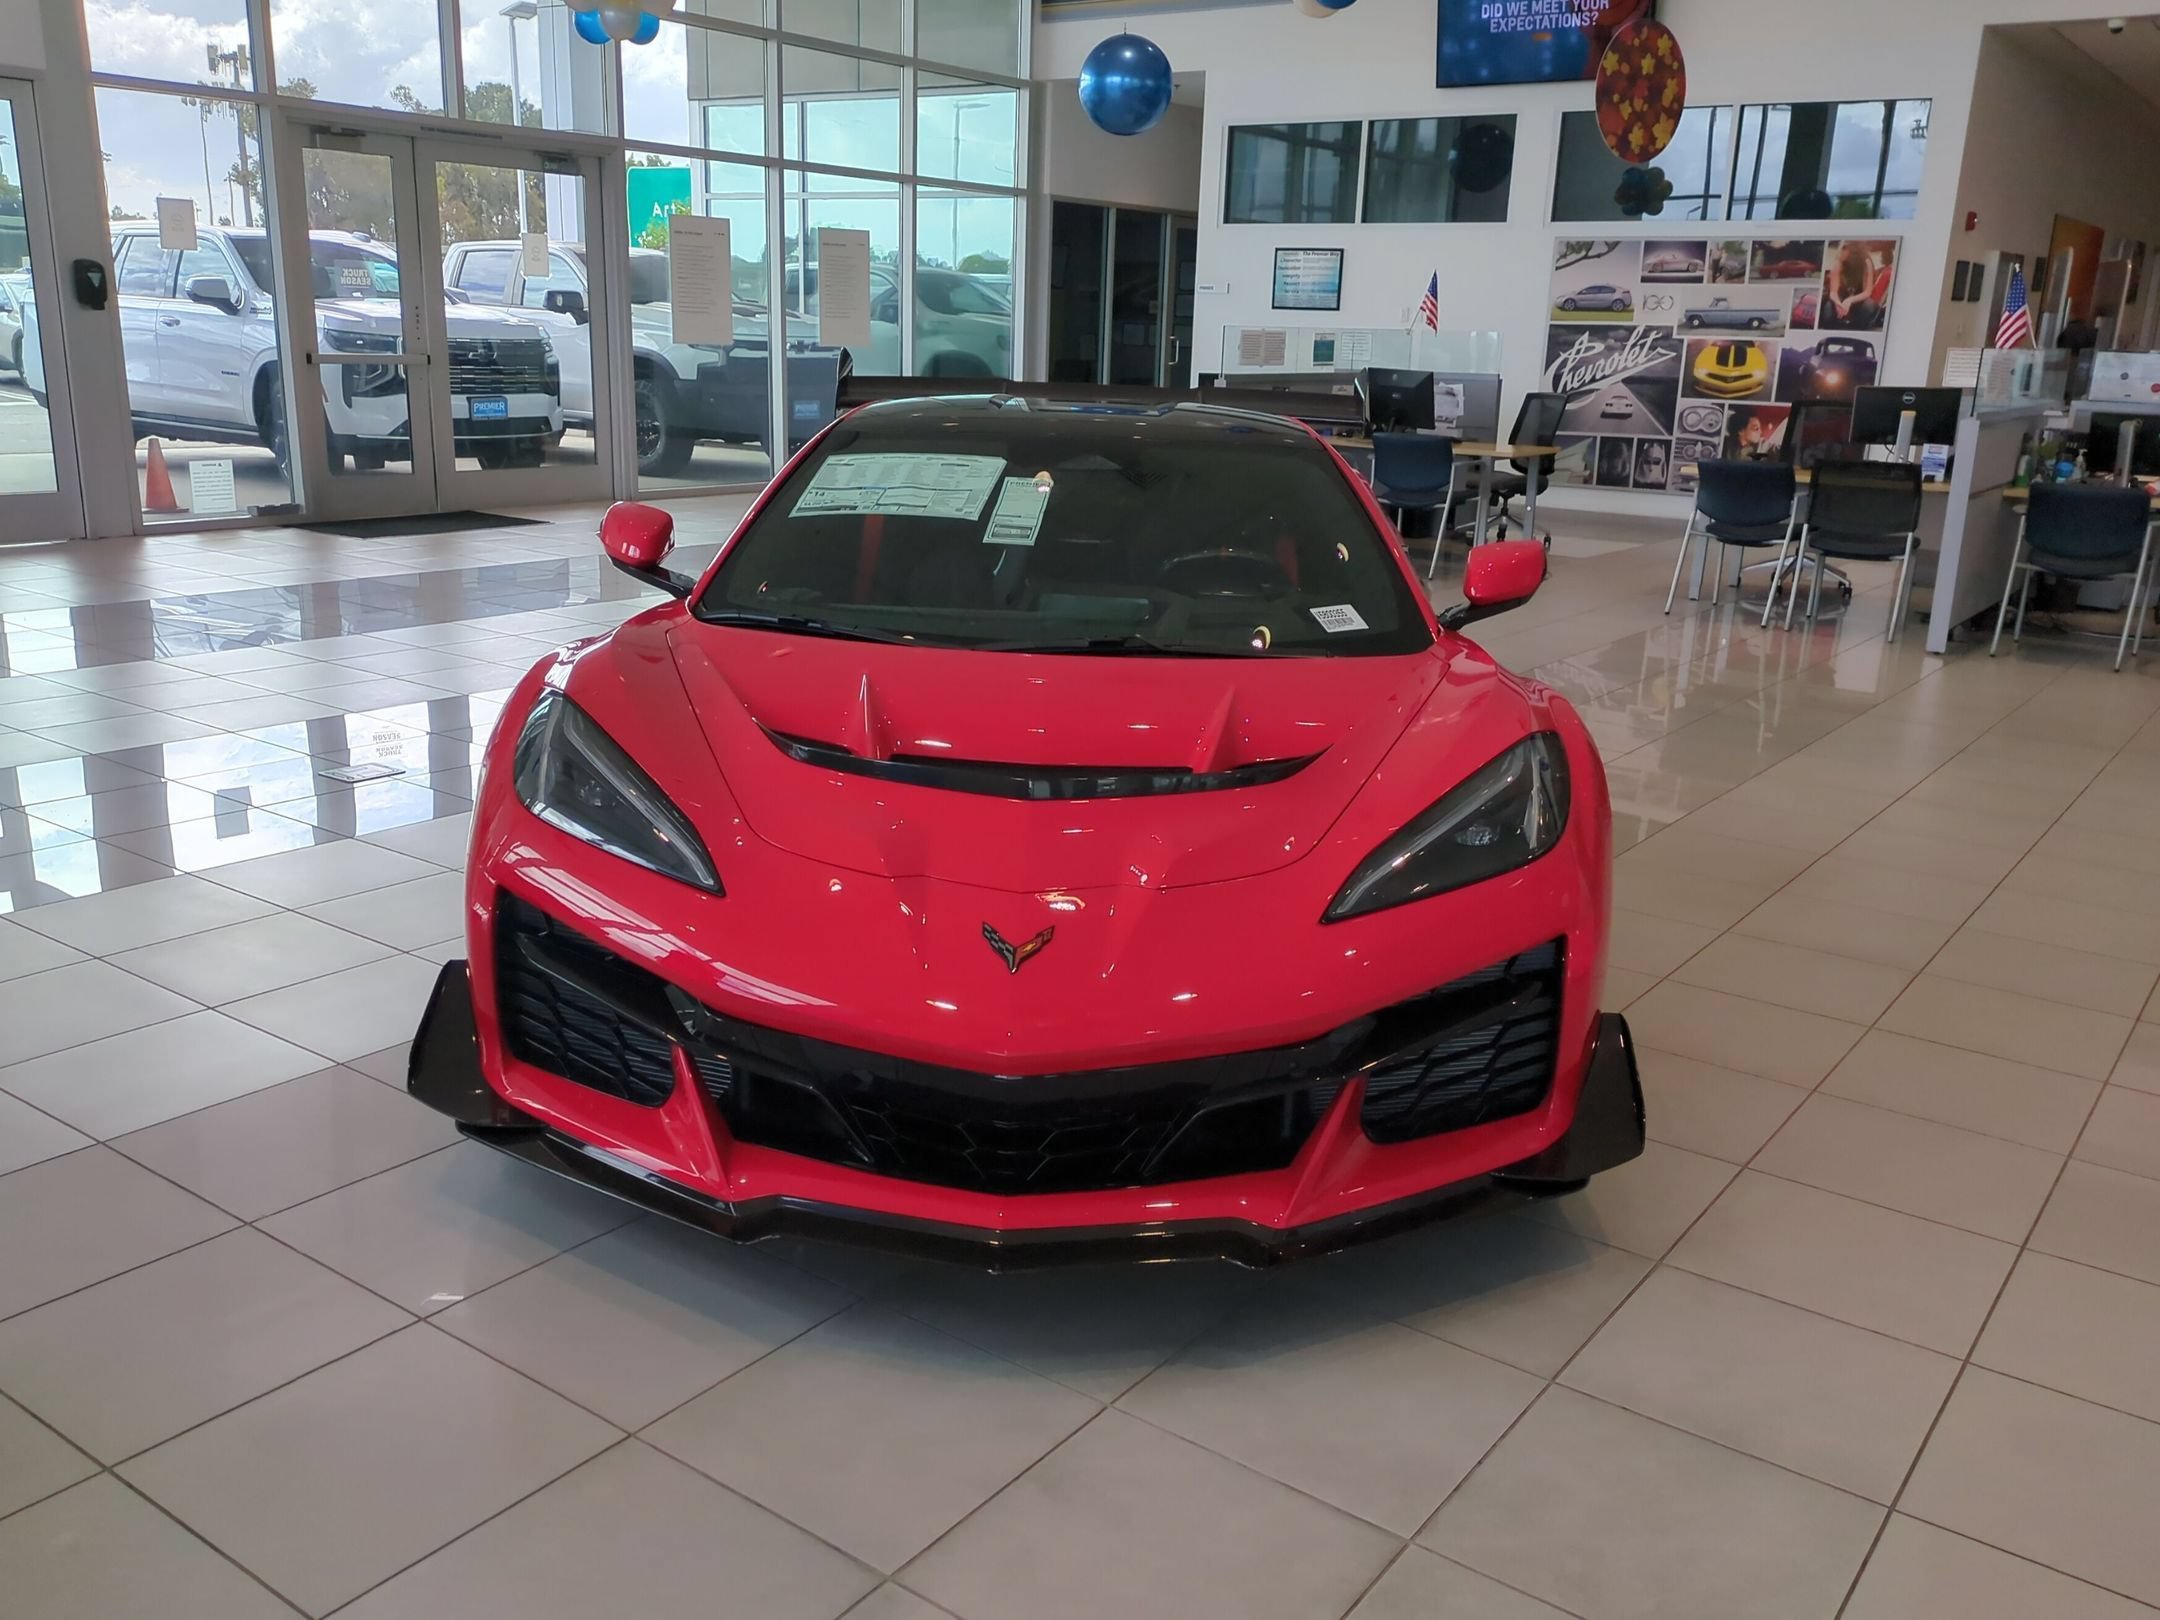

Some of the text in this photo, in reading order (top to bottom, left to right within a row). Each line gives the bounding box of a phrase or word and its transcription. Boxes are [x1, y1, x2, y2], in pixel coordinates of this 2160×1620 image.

[1481, 0, 1609, 18] DID WE MEET YOUR
[1490, 12, 1599, 33] EXPECTATIONS?
[1544, 325, 1677, 399] Chevrolet
[473, 402, 505, 413] PREMIER
